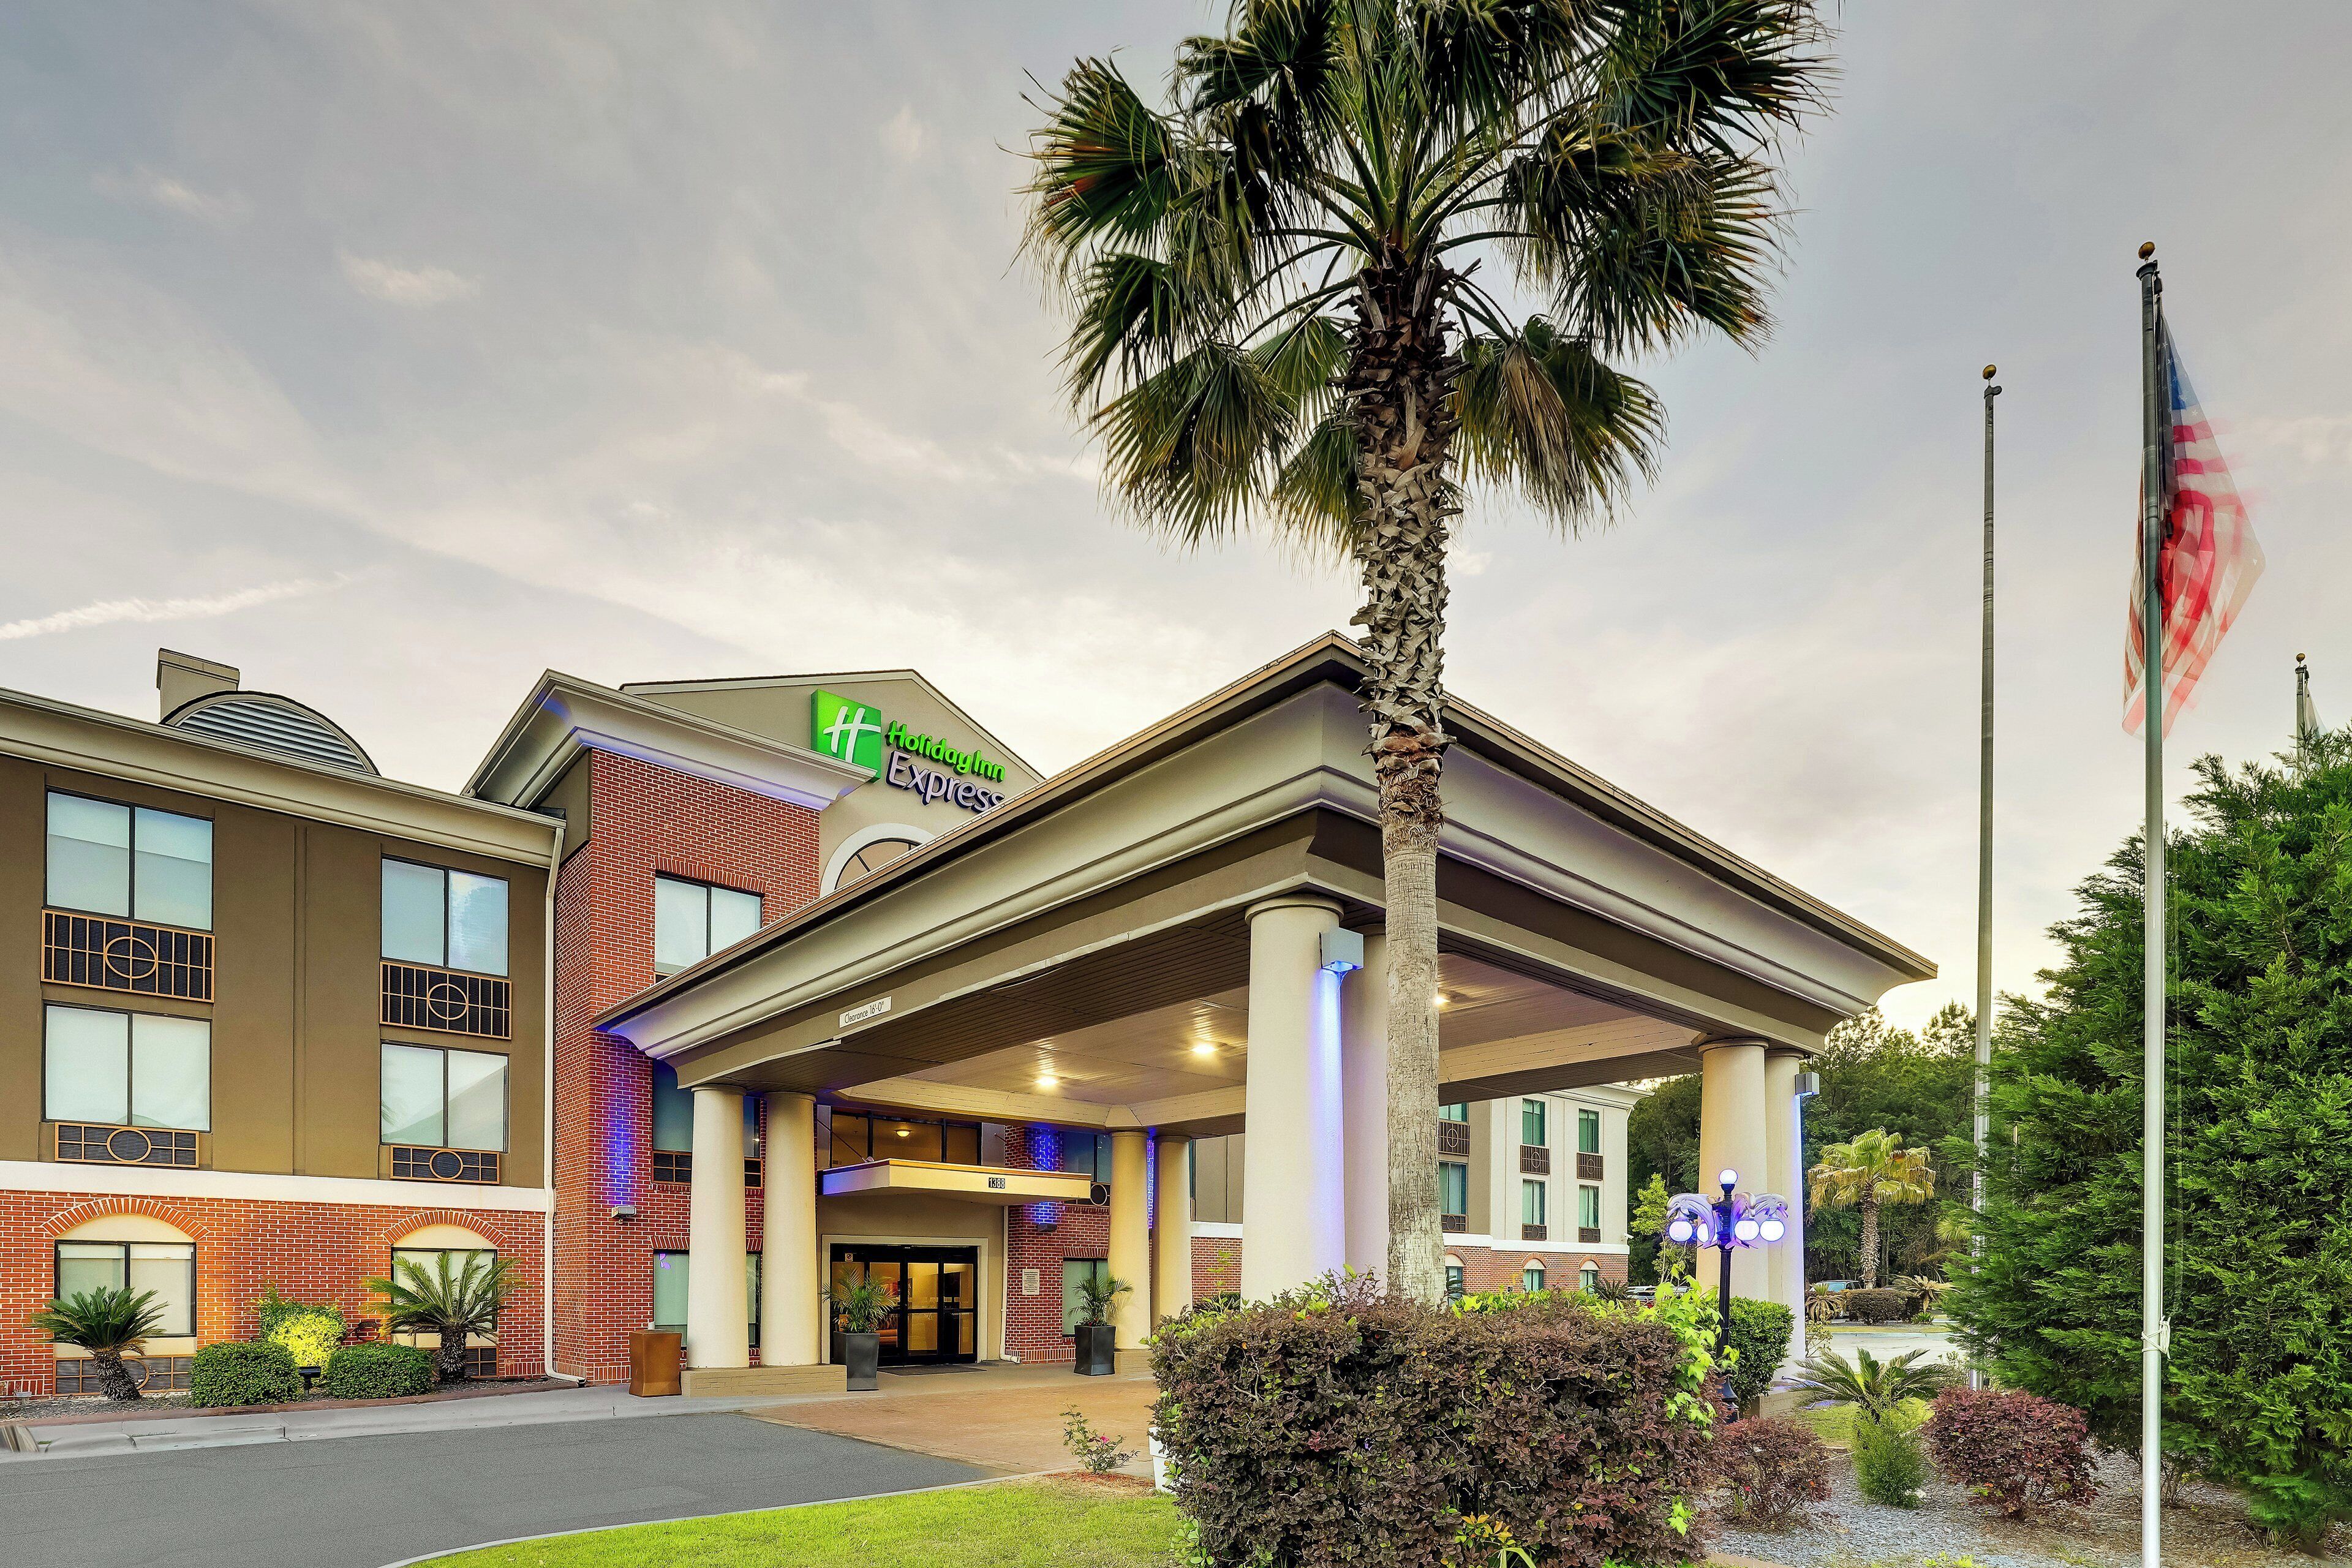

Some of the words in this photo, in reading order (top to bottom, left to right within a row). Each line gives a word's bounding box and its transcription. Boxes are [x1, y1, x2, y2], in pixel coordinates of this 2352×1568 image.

[886, 720, 972, 774] Holiday
[972, 750, 1005, 782] Inn
[886, 750, 1005, 812] Express
[845, 1010, 868, 1023] Clearance
[989, 1178, 1005, 1188] 1388
